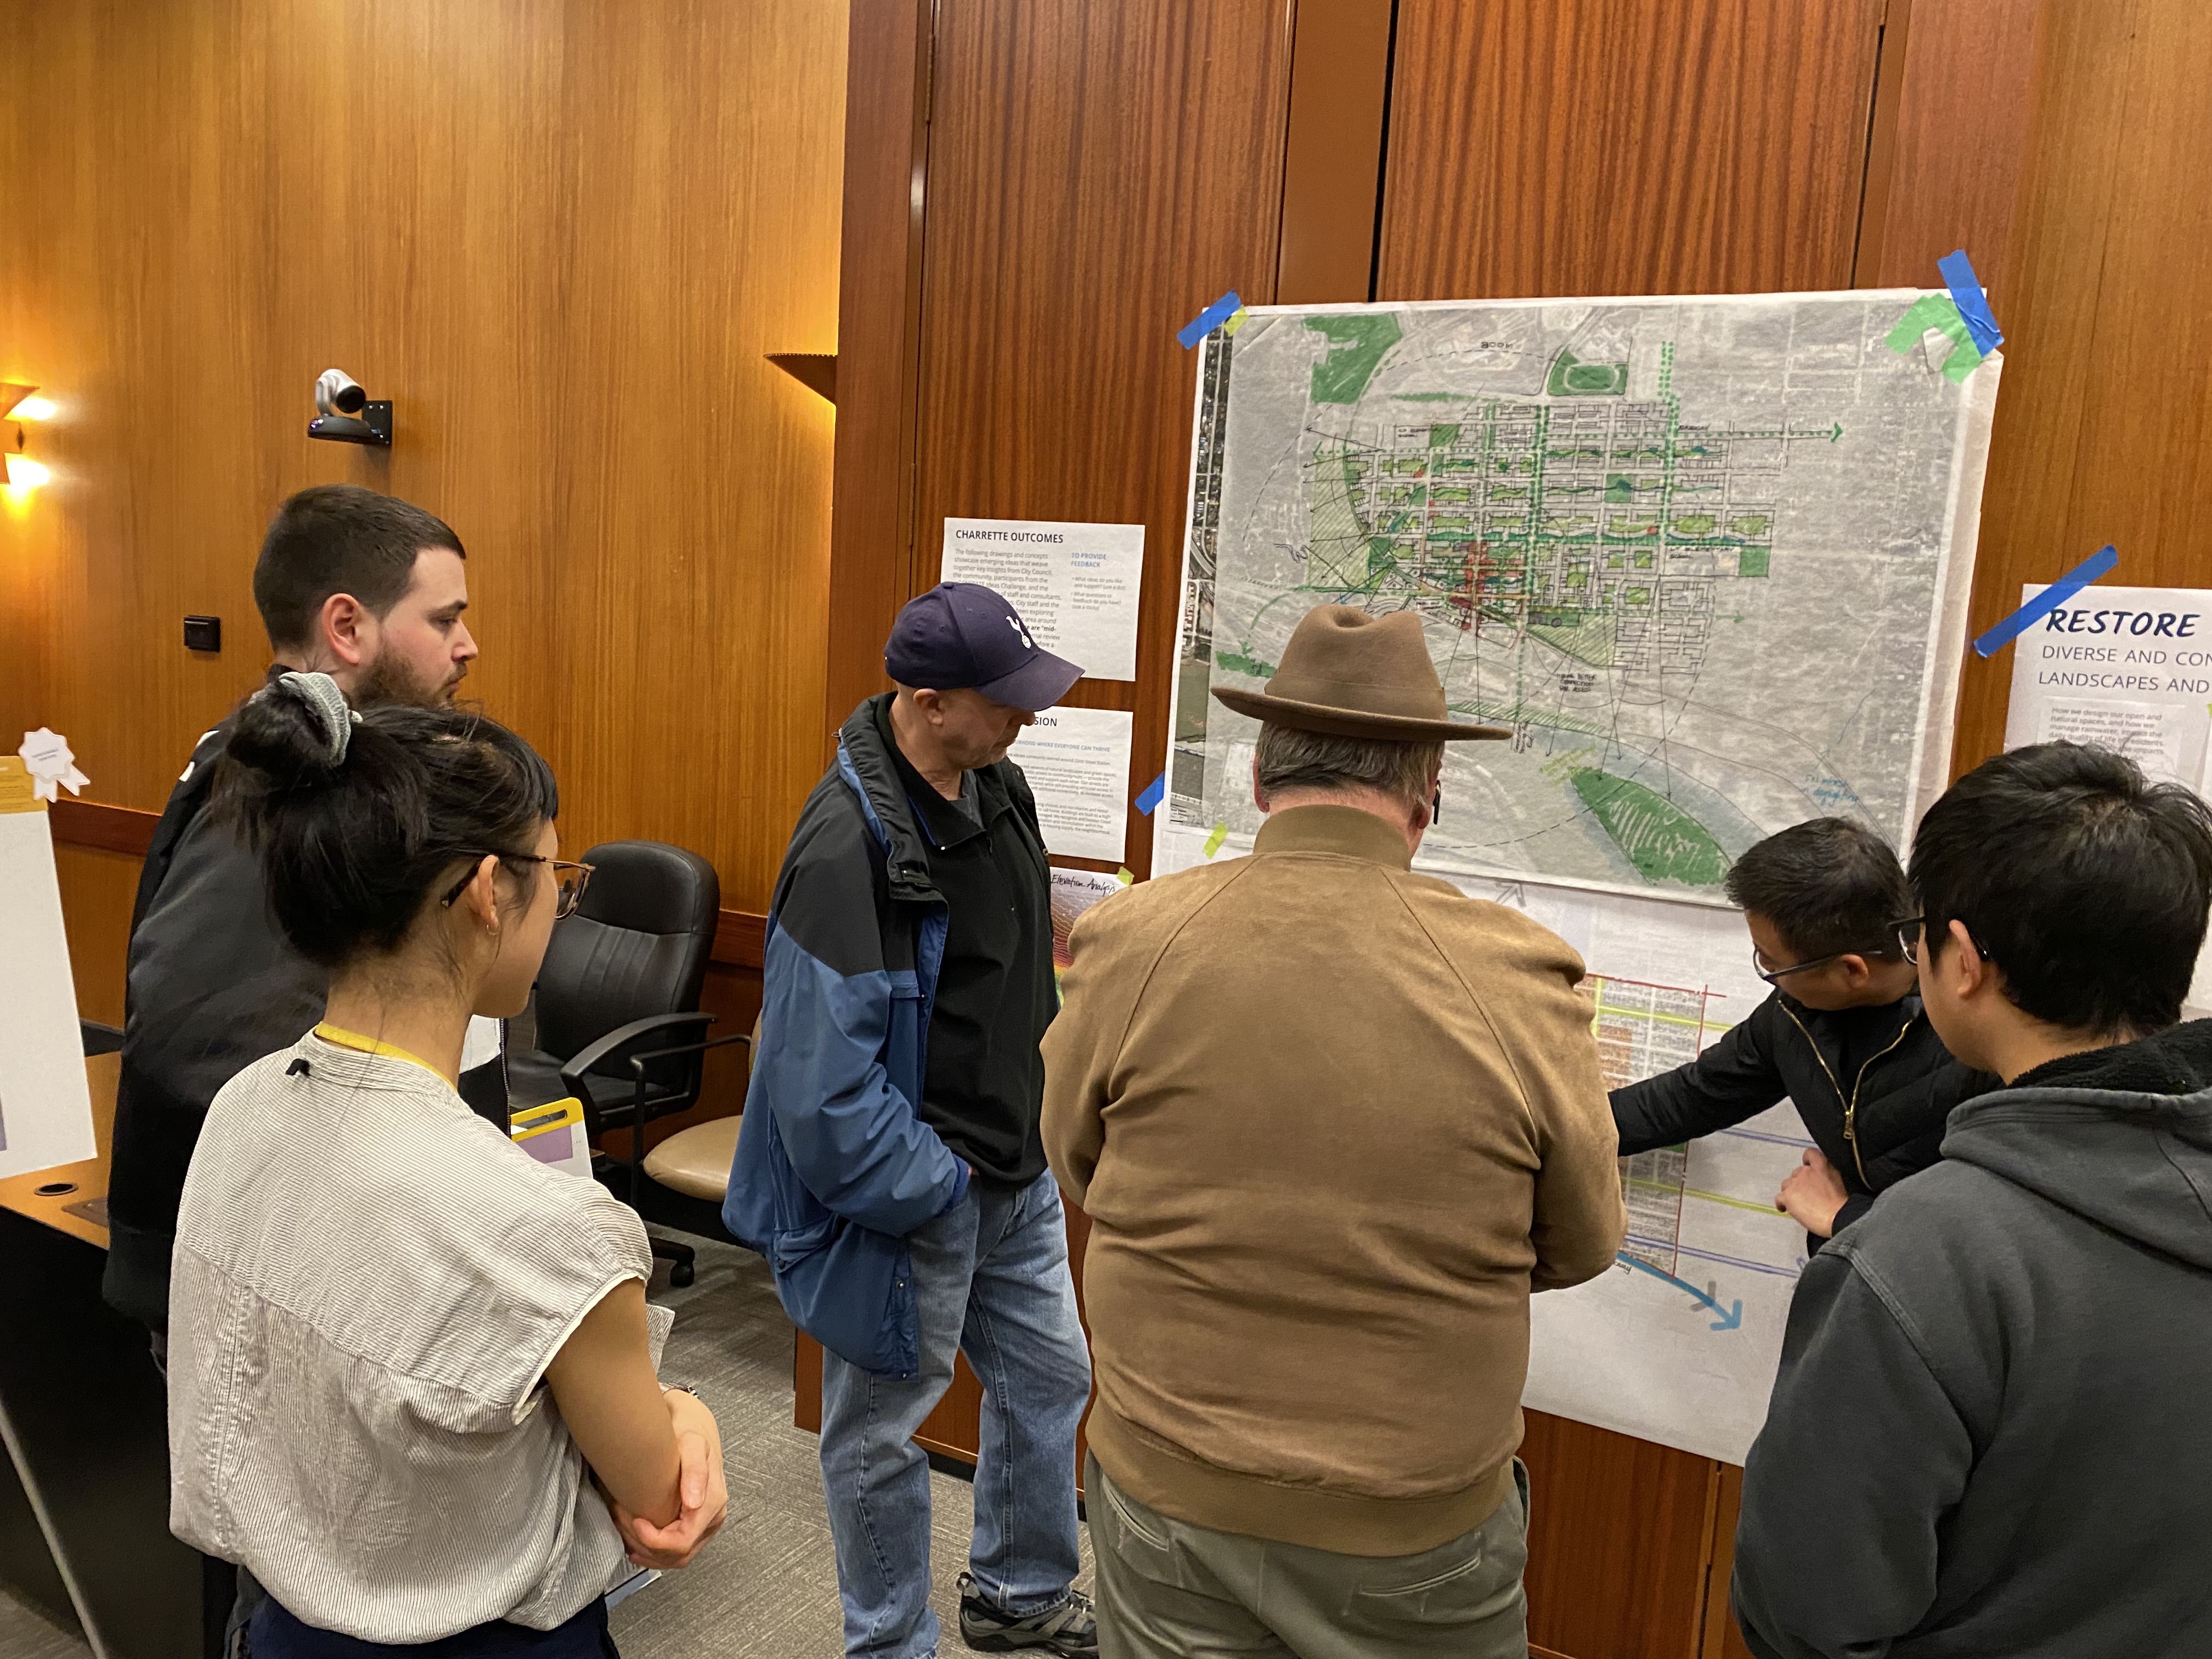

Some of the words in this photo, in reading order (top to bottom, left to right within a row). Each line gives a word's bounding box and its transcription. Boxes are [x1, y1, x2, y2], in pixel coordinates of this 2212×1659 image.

[956, 530, 1008, 541] CHARRETTE
[1011, 533, 1063, 543] OUTCOMES
[2046, 609, 2201, 637] RESTORE
[2042, 645, 2118, 662] DIVERSE
[2125, 650, 2166, 664] AND
[2039, 672, 2159, 690] LANDSCAPES
[2166, 679, 2210, 693] AND
[1034, 716, 1057, 726] SION
[1051, 874, 1086, 887] Elevation
[1087, 878, 1115, 897] Analysis
